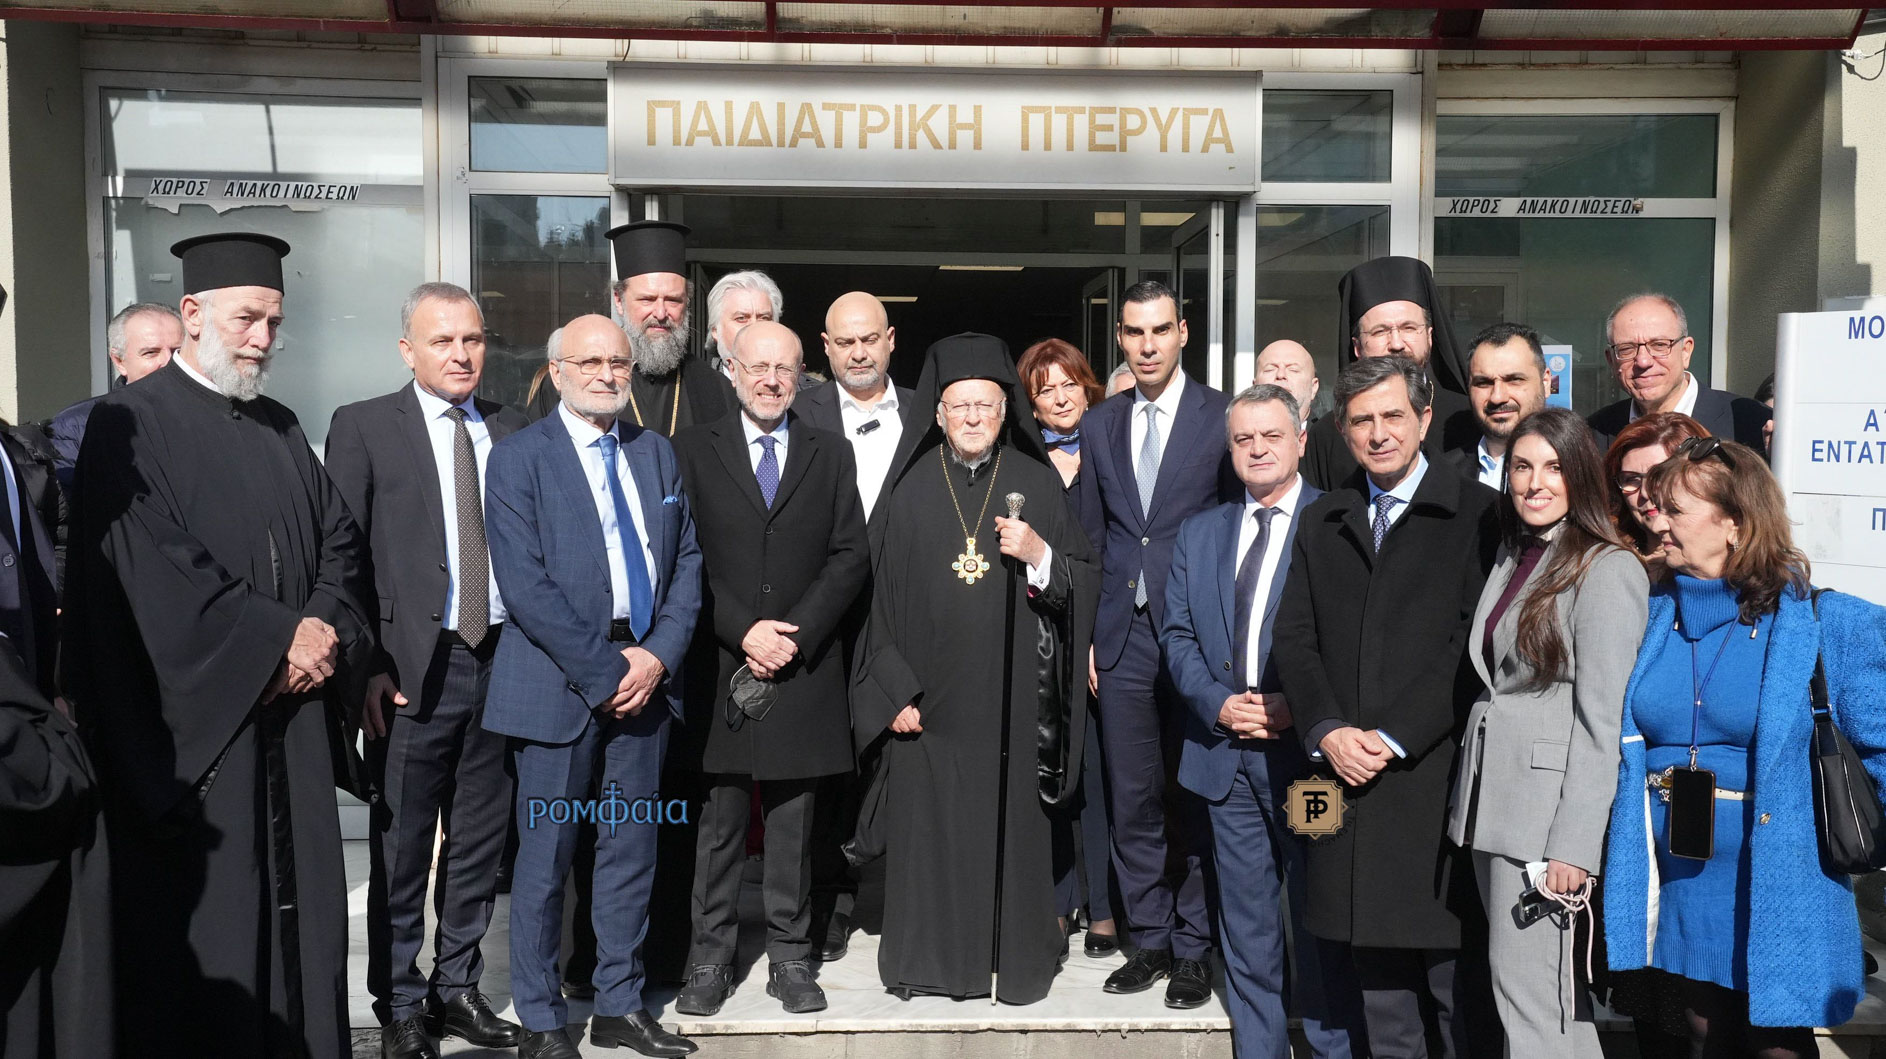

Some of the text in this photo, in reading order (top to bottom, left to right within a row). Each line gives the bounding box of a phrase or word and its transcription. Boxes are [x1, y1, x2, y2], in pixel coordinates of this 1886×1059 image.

[646, 99, 1235, 154] ΠΑΙΔΙΑΤΡΙΚΗ ΠΤΕΡΥΓΑ
[151, 178, 359, 201] ΧΩΡΟΣ ΑΝΑΚΟΙΝΩΣΕΩΝ
[1449, 198, 1501, 214] ΧΩΡΟΣ
[1811, 439, 1886, 464] ΕΝΤΑΤ
